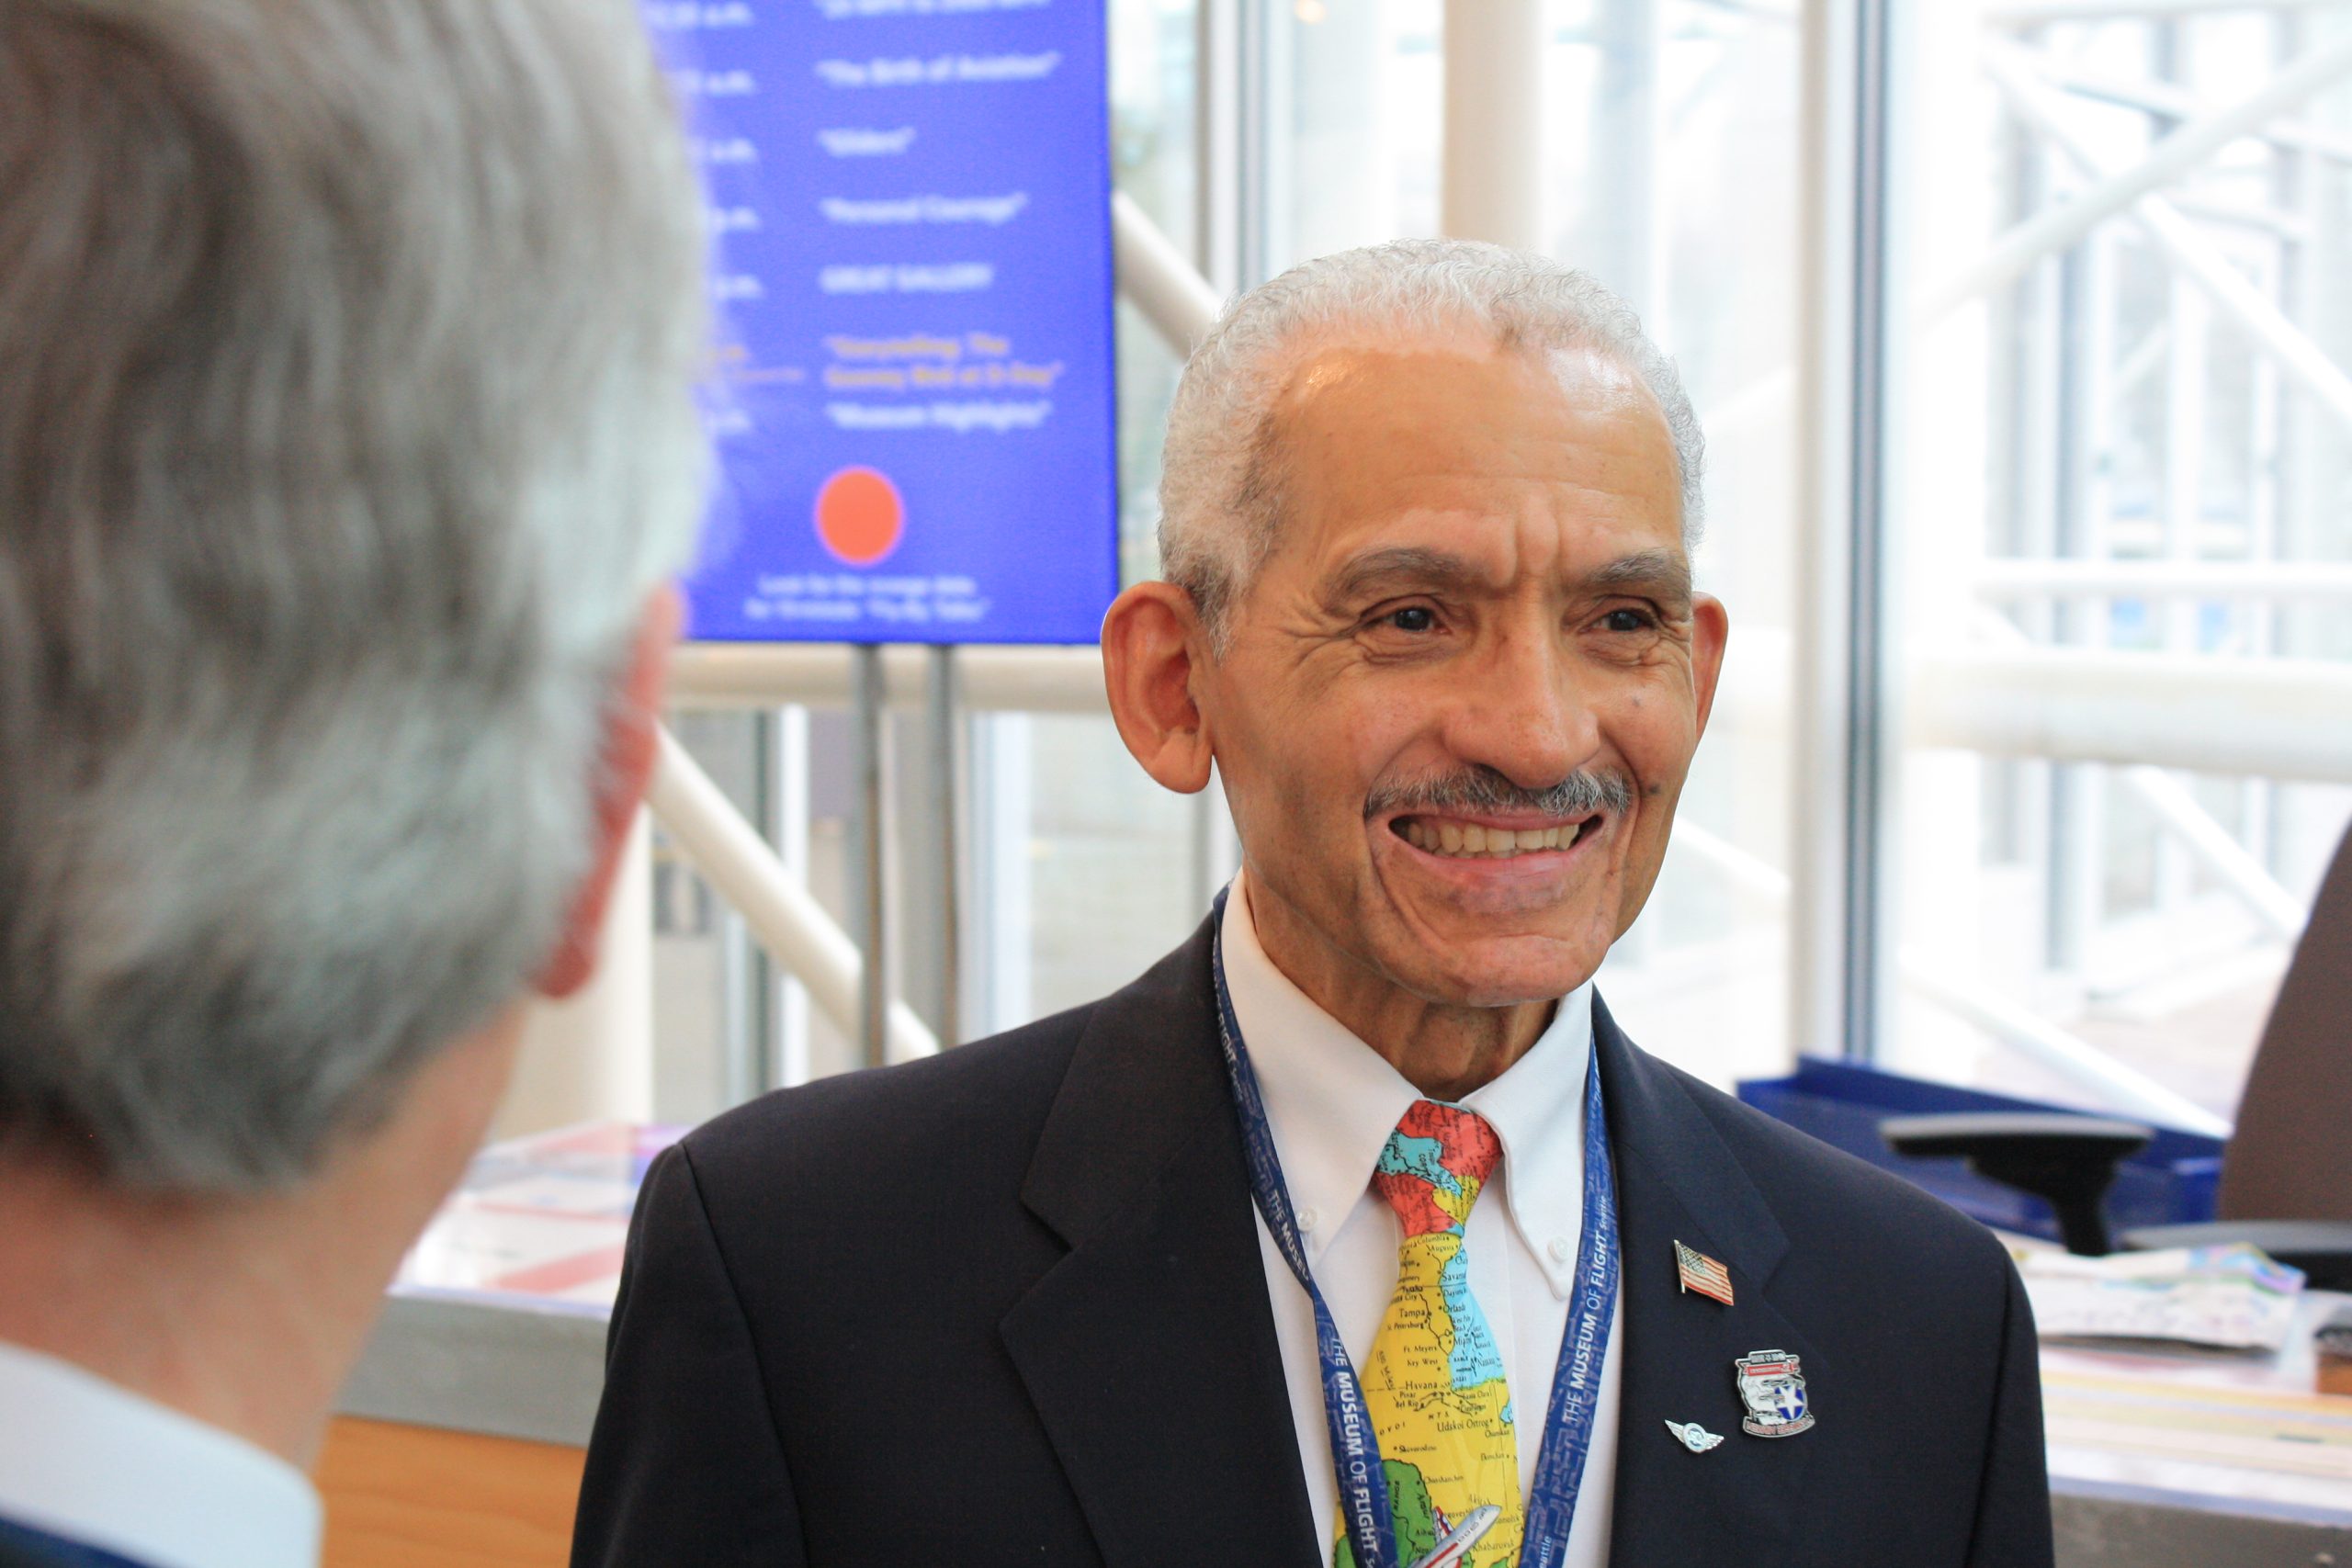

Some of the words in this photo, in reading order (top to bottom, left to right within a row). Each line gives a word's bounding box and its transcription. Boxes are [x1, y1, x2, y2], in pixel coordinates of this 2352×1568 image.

[1590, 1230, 1607, 1288] FLIGHT
[1399, 1308, 1425, 1318] Tampa
[1586, 1288, 1601, 1310] OF
[1332, 1337, 1348, 1367] THE
[1570, 1312, 1598, 1390] MUSEUM
[1405, 1381, 1438, 1391] Havana
[1336, 1371, 1363, 1456] MUSEUM
[1562, 1391, 1581, 1424] THE
[1350, 1461, 1368, 1484] OF
[1354, 1488, 1377, 1552] FLIGHT
